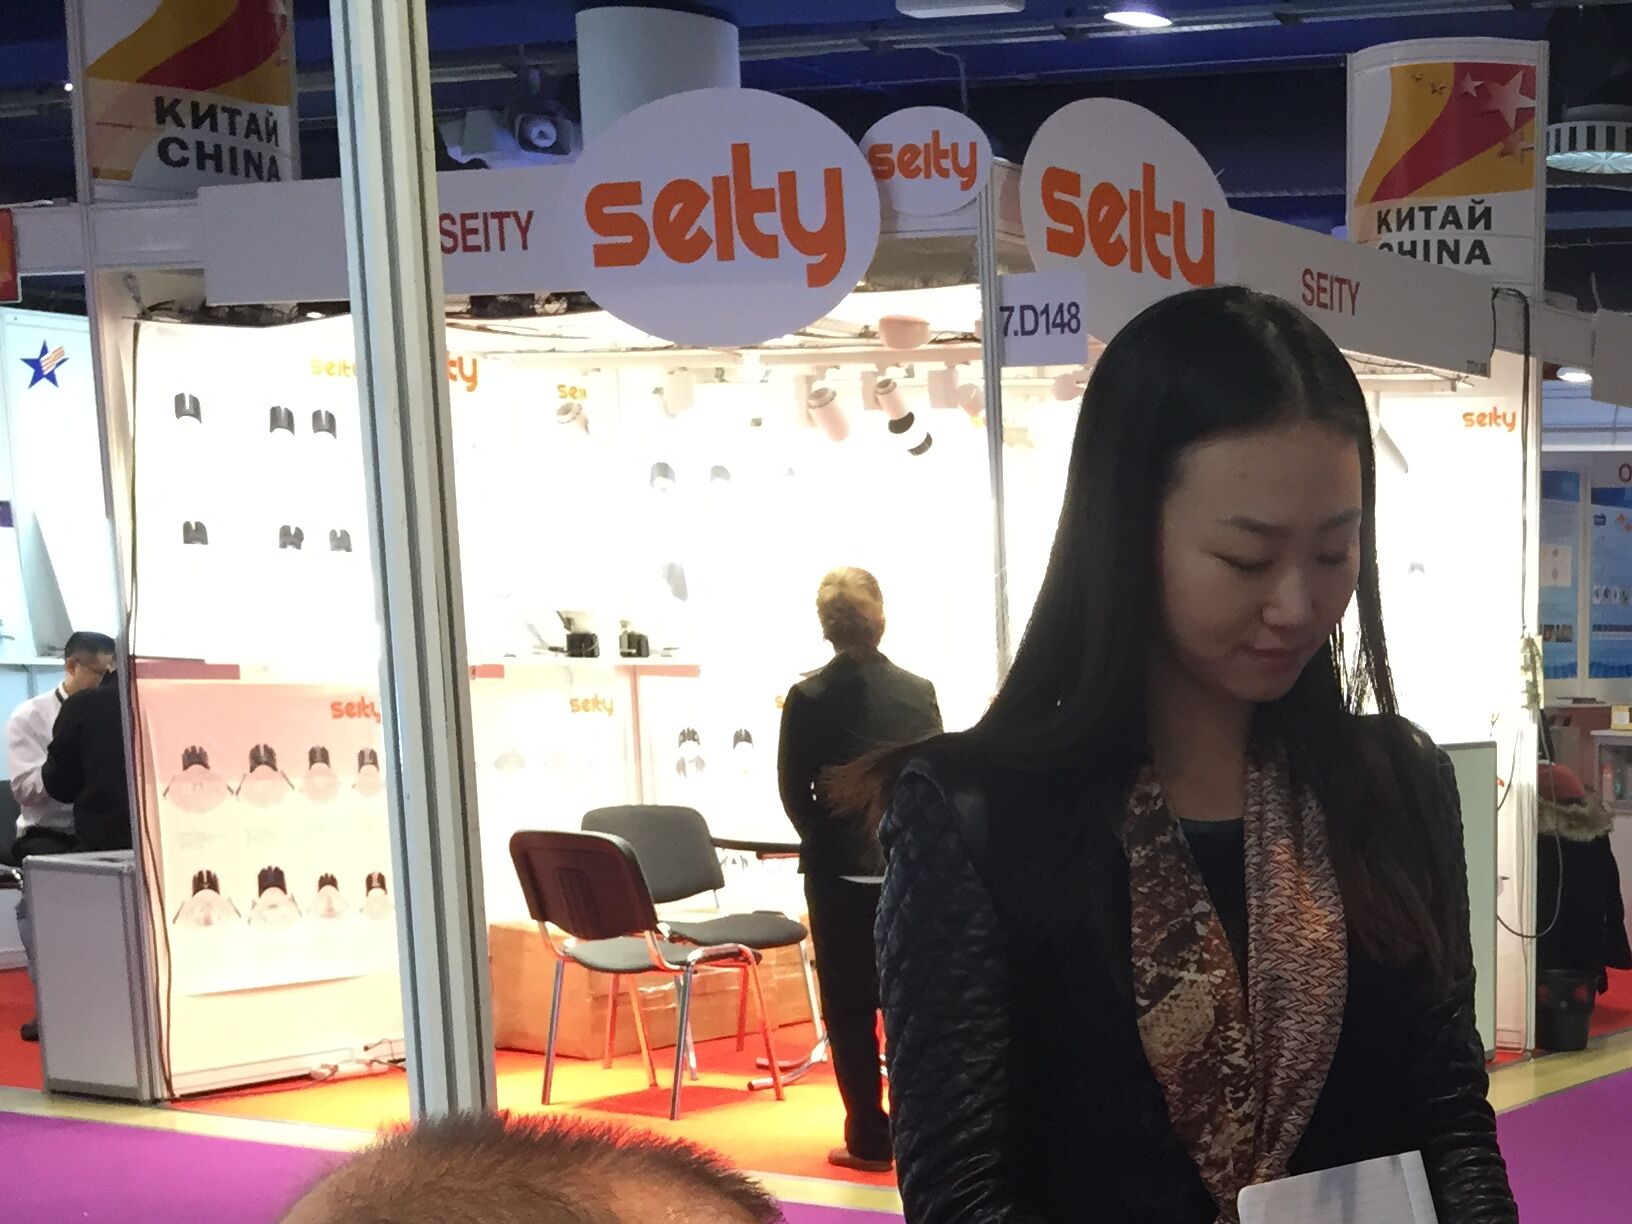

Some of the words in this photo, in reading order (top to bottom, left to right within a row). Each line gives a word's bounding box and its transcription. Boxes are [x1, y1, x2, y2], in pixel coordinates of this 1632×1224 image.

[154, 96, 279, 147] КИТАЙ
[157, 136, 281, 182] CHINA
[867, 130, 978, 191] seity
[438, 210, 534, 254] SEITY
[584, 142, 848, 288] seity
[1376, 198, 1493, 235] КИТАЙ
[1301, 267, 1361, 316] SEITY
[1000, 302, 1082, 338] 7.D148
[1462, 406, 1517, 433] seity
